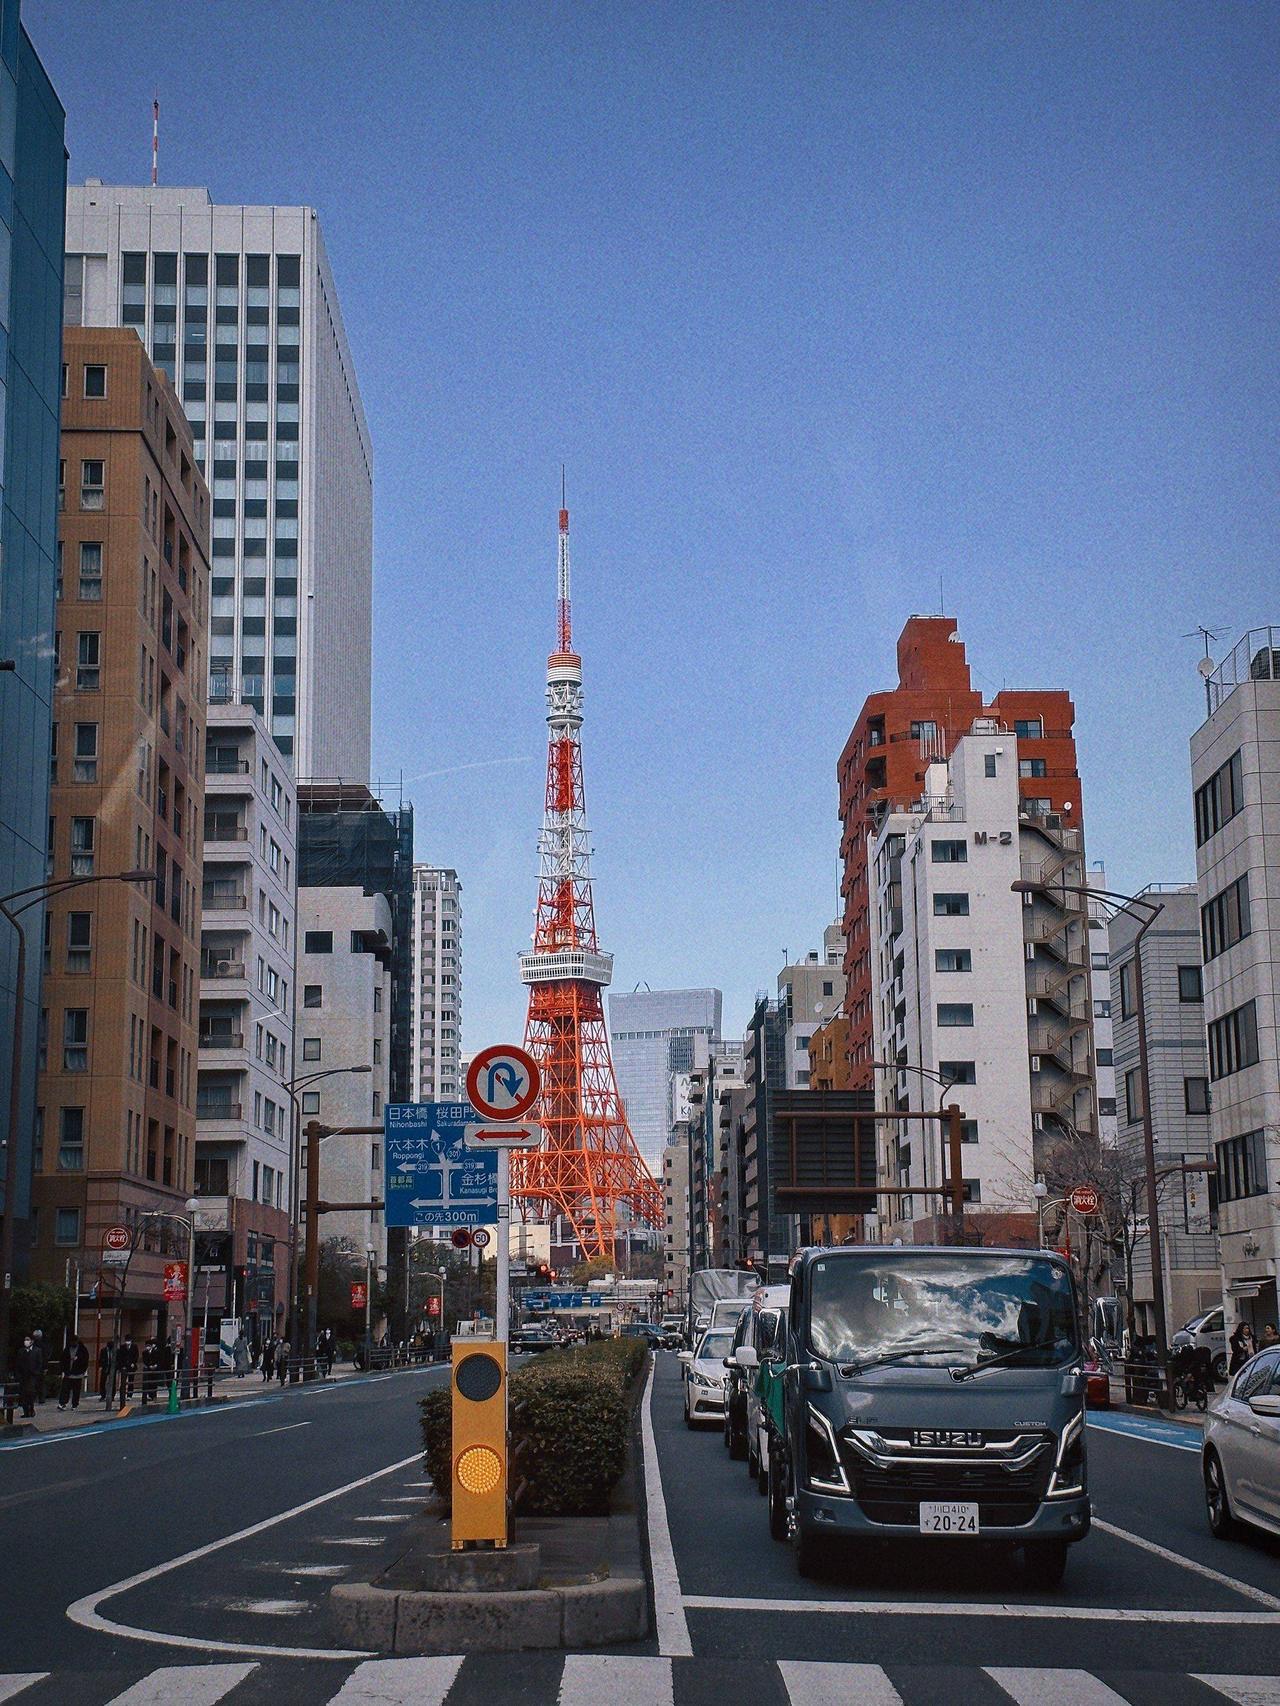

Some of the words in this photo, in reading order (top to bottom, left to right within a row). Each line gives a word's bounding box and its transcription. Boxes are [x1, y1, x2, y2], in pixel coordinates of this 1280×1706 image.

[974, 831, 1012, 845] M-2
[389, 1106, 428, 1120] 日本橋
[436, 1105, 476, 1119] 桜田門
[389, 1120, 427, 1128] Nihonbashi
[388, 1138, 429, 1151] 六本木
[436, 1142, 440, 1151] 1
[392, 1152, 425, 1160] Roppongi
[418, 1162, 428, 1170] 319
[464, 1161, 475, 1169] 319
[460, 1186, 487, 1195] Kanasugi
[415, 1211, 477, 1222] この先300m
[475, 1233, 486, 1243] 50
[913, 1431, 982, 1446] ISUZU
[951, 1505, 966, 1514] 410
[933, 1515, 976, 1531] 20-24
